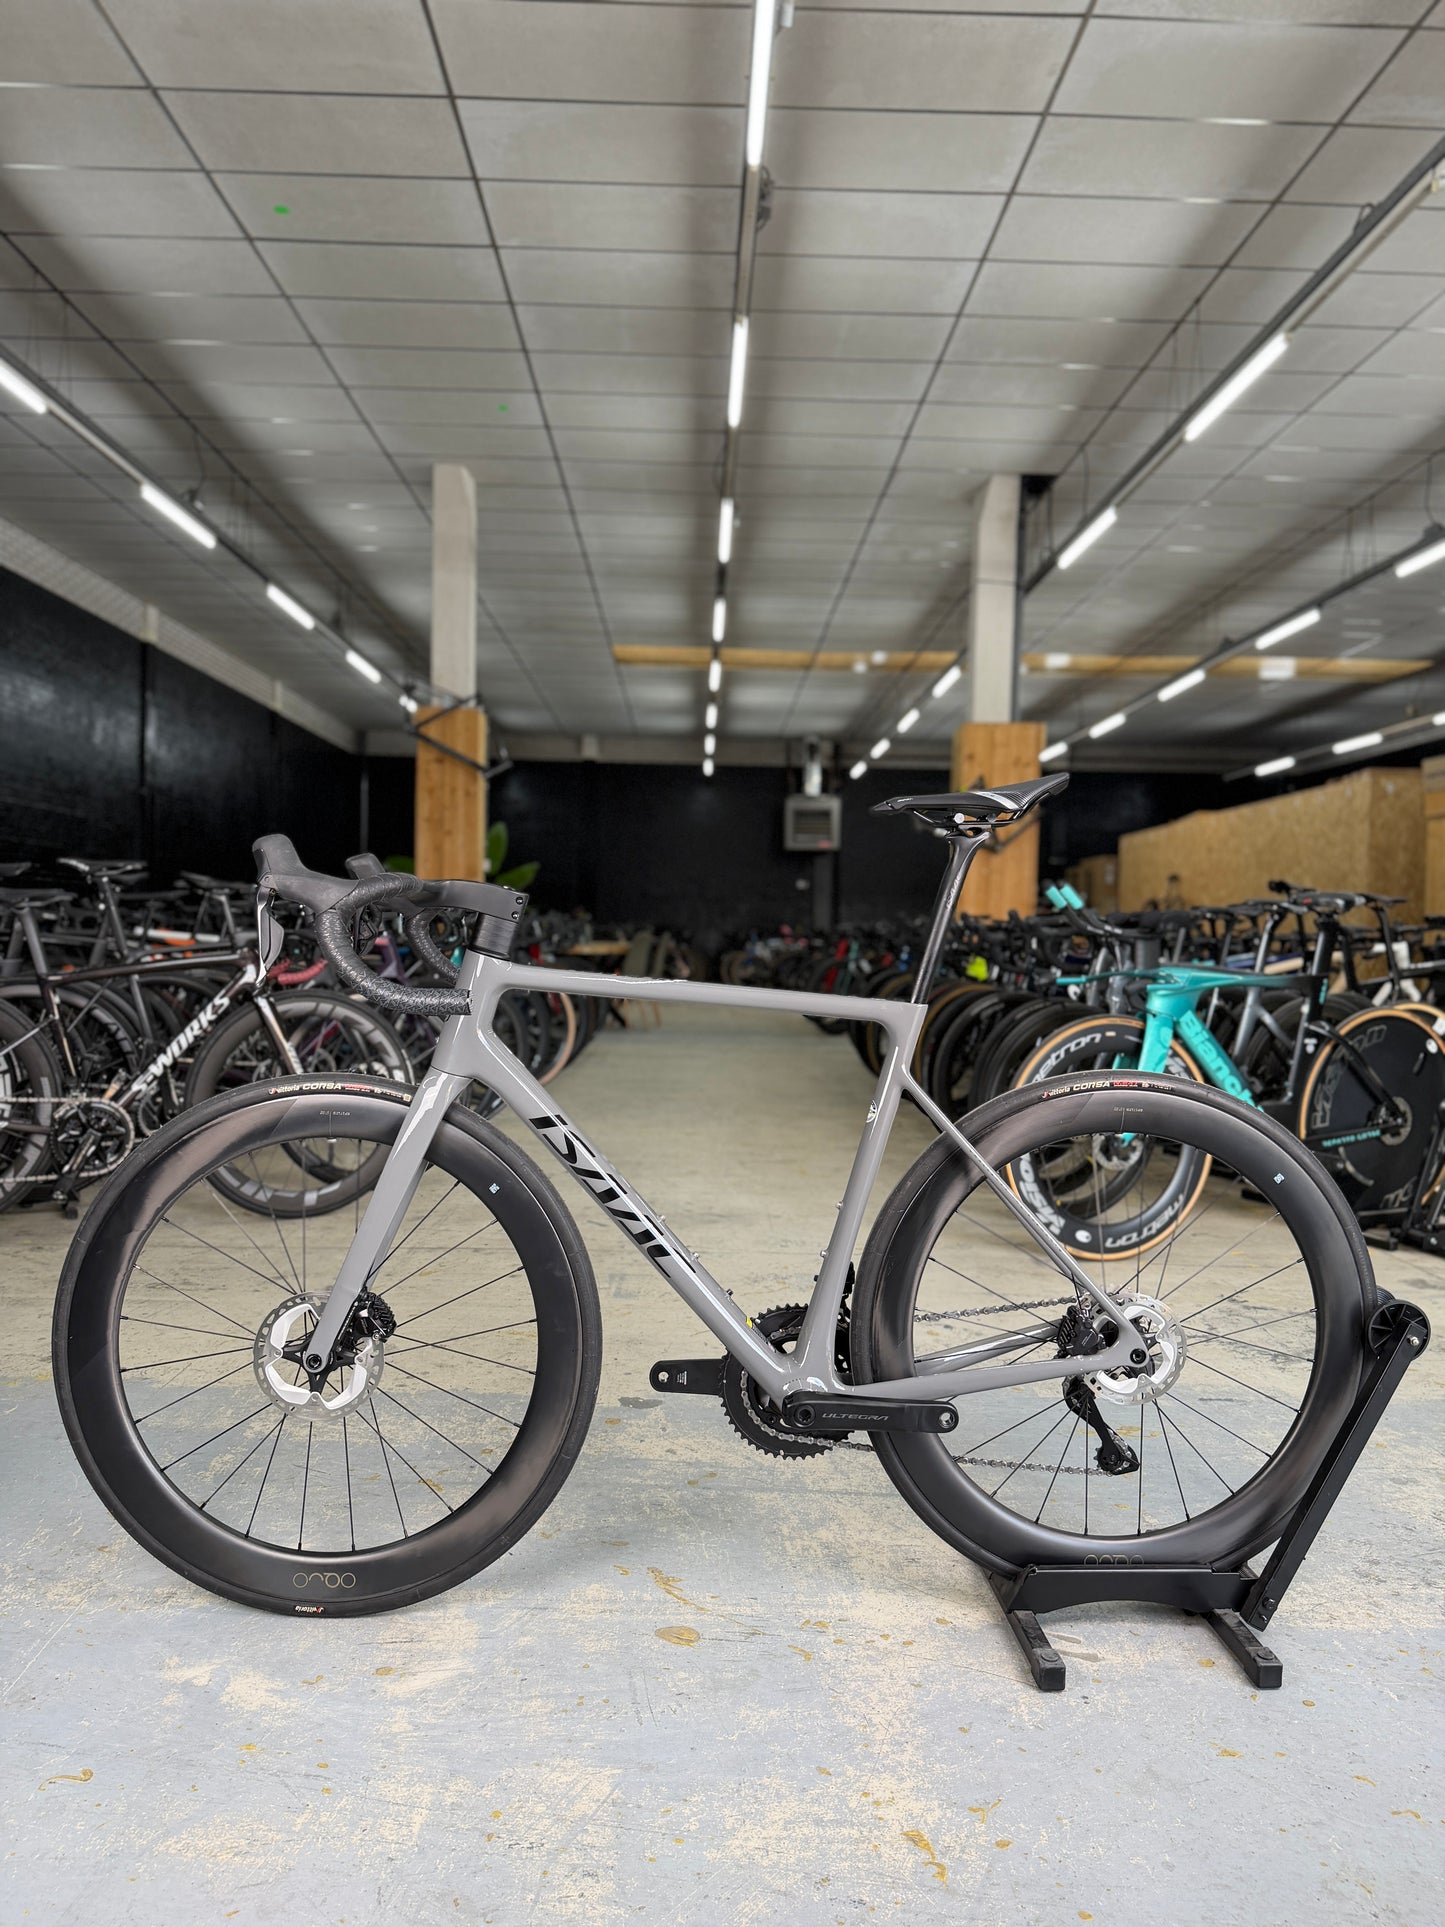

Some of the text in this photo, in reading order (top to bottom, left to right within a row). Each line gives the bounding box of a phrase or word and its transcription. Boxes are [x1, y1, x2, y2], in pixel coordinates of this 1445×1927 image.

[131, 992, 230, 1098] S-WORKS
[1180, 1009, 1264, 1113] Bianch
[277, 1084, 300, 1094] vittoria
[302, 1082, 342, 1091] CORSA
[1048, 1086, 1071, 1097] vittoria
[1073, 1081, 1111, 1091] CORSA
[822, 1413, 889, 1421] ULTEGRA
[293, 1572, 356, 1588] OQUO
